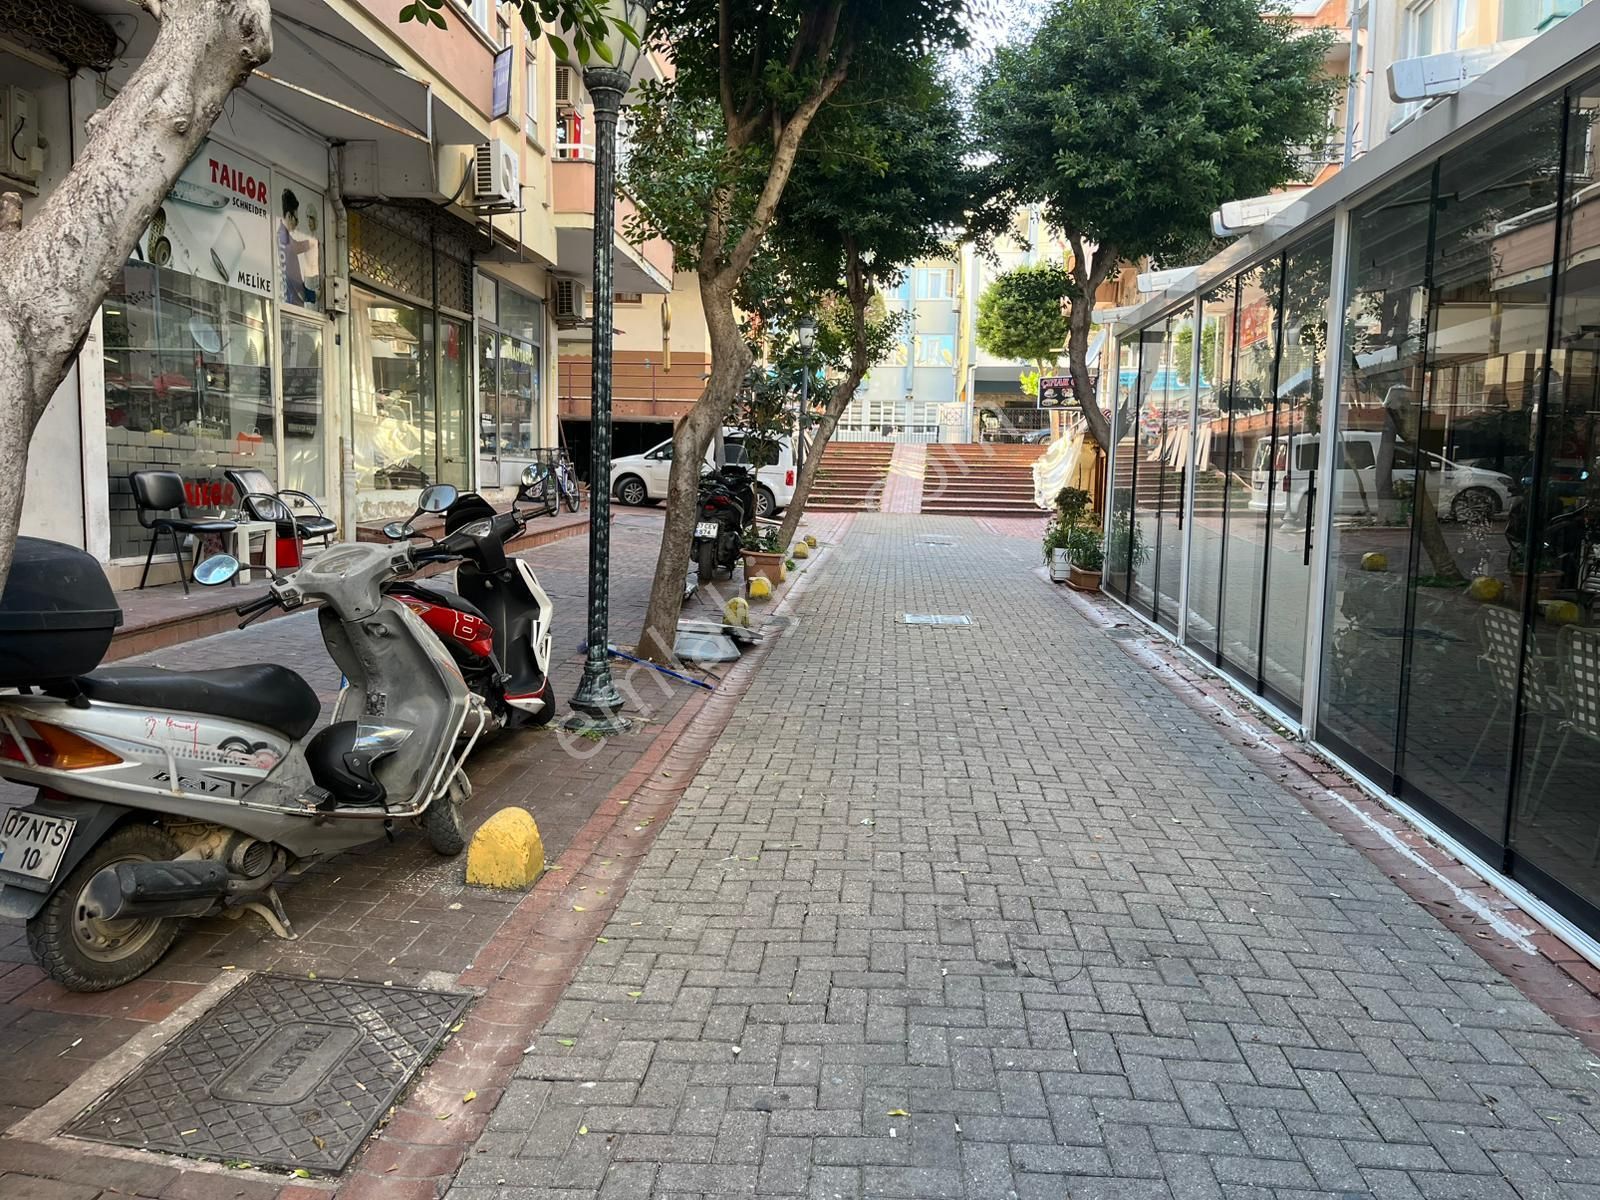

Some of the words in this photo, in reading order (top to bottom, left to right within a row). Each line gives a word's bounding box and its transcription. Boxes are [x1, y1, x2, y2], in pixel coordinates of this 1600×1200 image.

[209, 158, 268, 205] TAILOR
[232, 196, 268, 218] SCHNEIDER
[237, 271, 272, 293] MELİKE
[20, 847, 41, 871] 10
